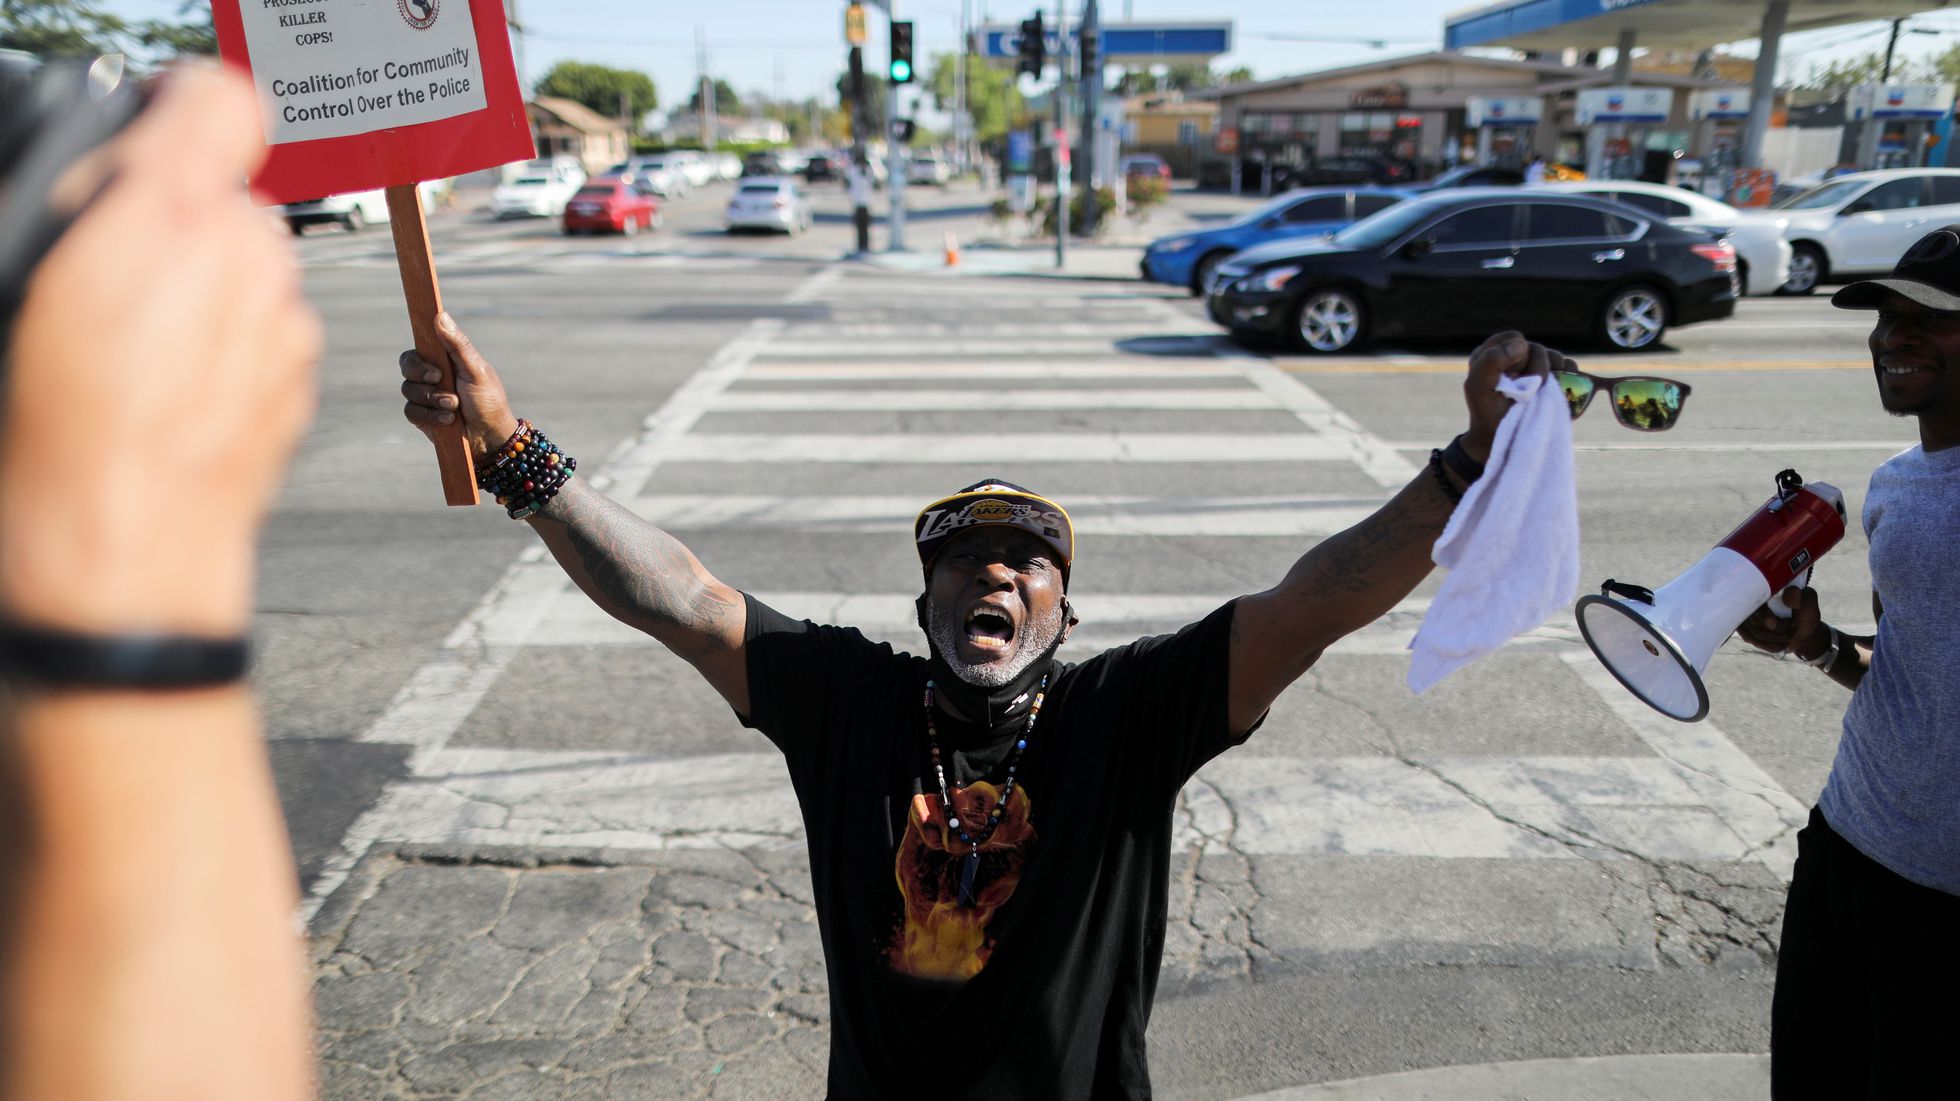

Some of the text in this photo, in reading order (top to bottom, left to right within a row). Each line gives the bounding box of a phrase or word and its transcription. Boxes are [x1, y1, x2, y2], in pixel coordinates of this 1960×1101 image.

[279, 11, 328, 28] KILLER
[295, 31, 334, 46] COPS!
[272, 47, 469, 97] Coalition for Community
[283, 77, 470, 123] Control Over the Police
